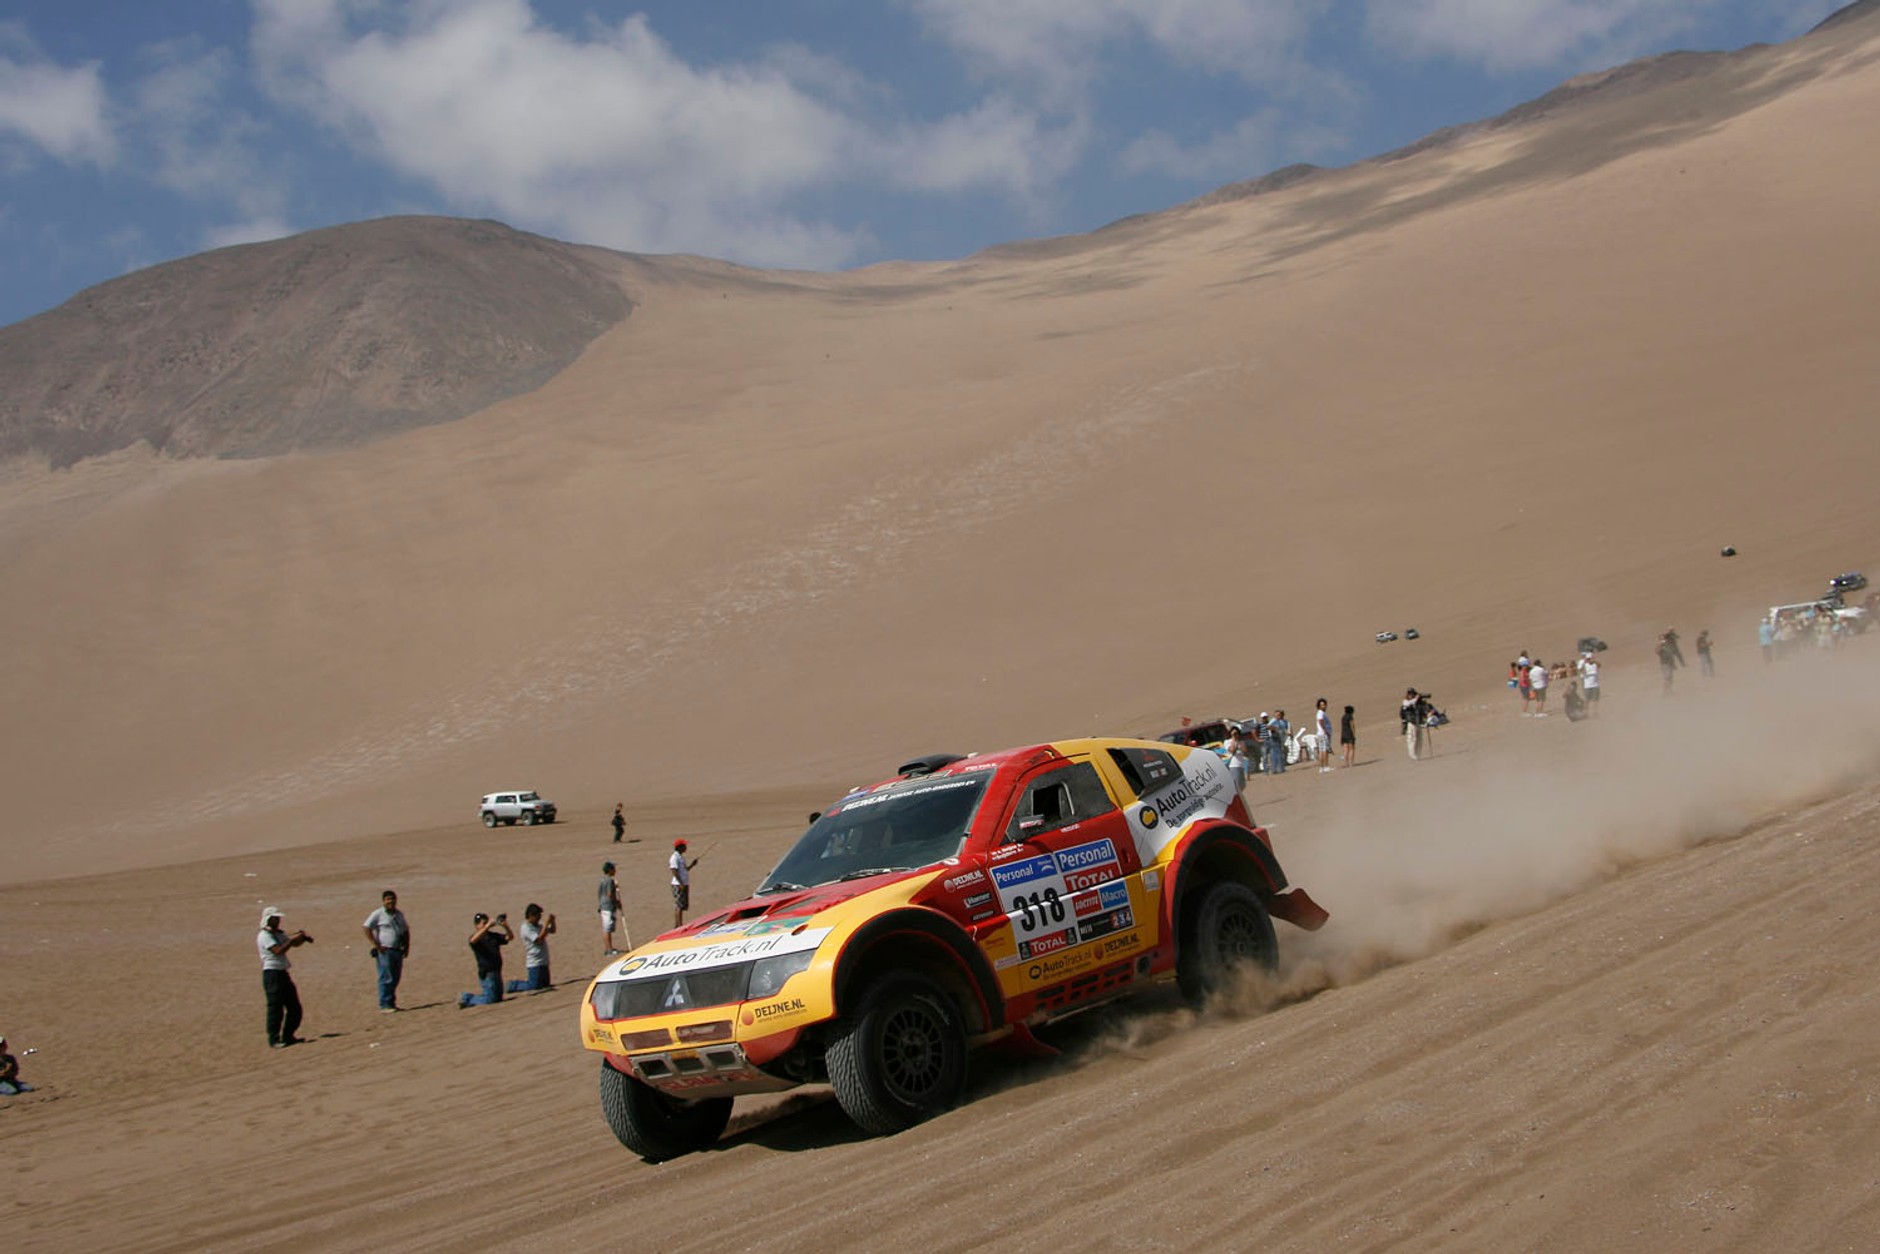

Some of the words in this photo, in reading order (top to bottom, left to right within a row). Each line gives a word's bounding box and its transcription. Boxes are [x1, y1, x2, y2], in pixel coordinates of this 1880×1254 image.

[1156, 762, 1217, 817] AutoTrack.nl
[1059, 841, 1112, 869] Personal
[996, 864, 1034, 883] Personal
[1066, 869, 1115, 891] TOTAL
[1075, 896, 1099, 910] LOCTITE
[1102, 889, 1126, 902] Macro
[1013, 887, 1066, 932] 318
[644, 935, 784, 970] AutoTrack.nl
[1031, 936, 1067, 952] TOTAL
[754, 998, 806, 1018] DEIJNE.NL
